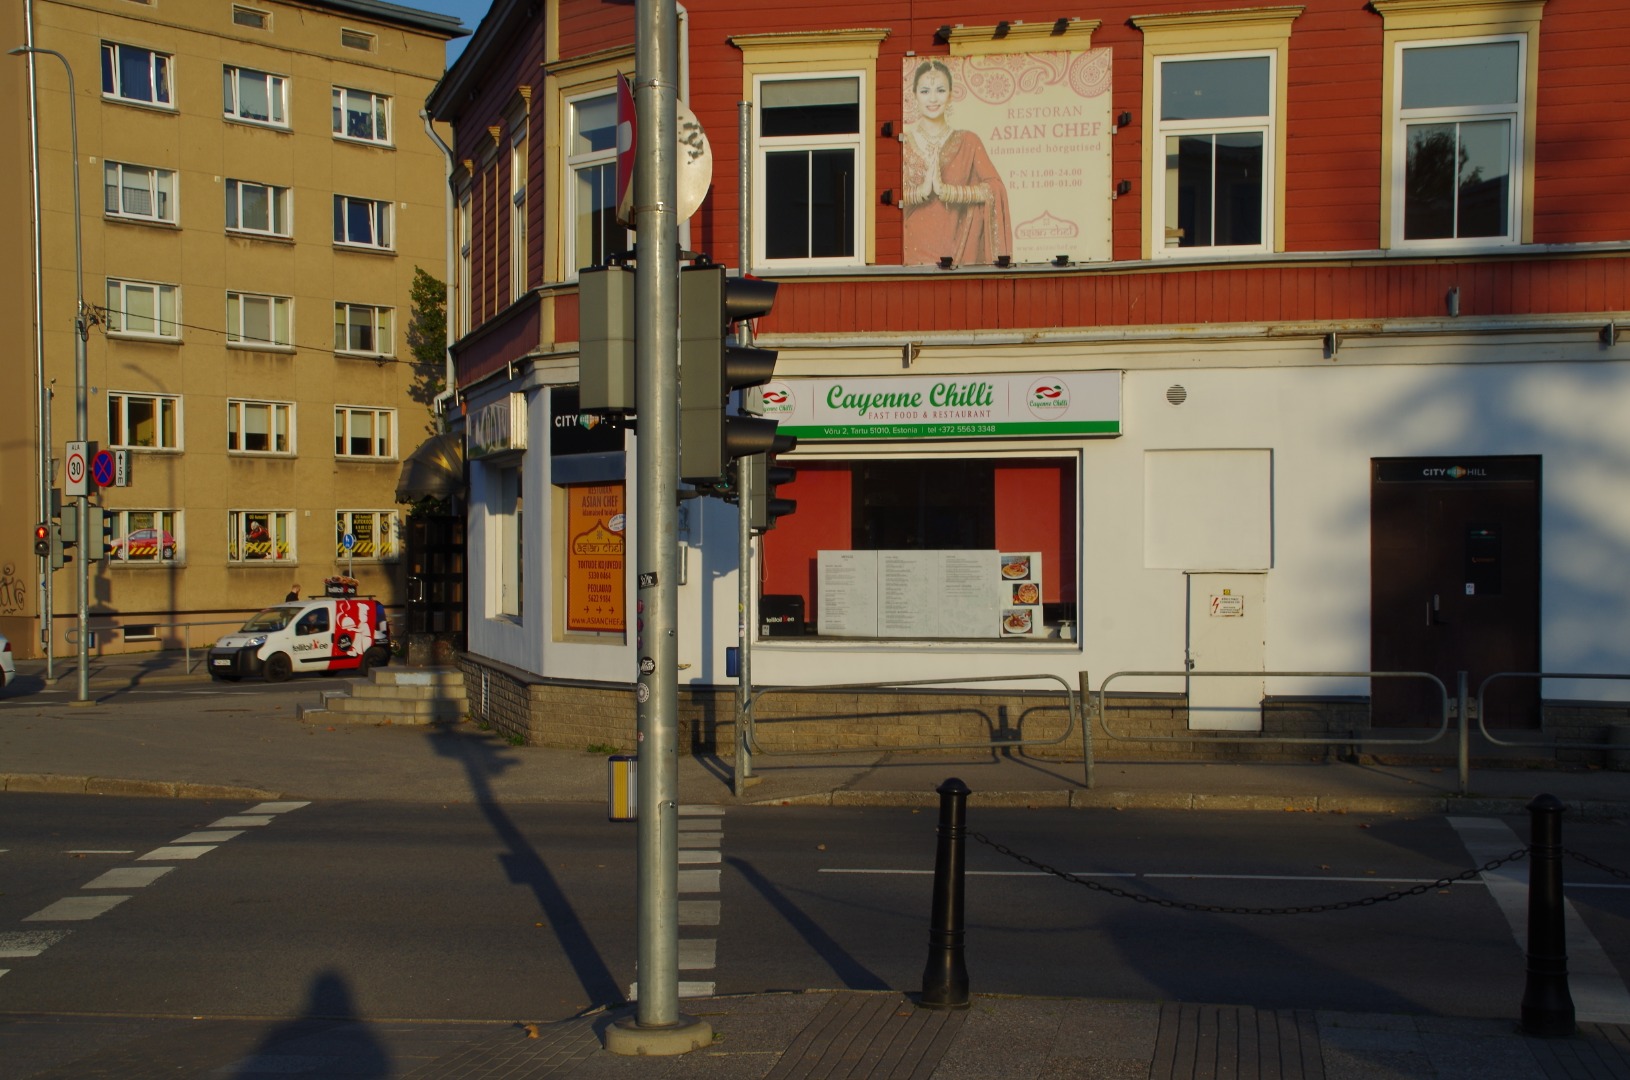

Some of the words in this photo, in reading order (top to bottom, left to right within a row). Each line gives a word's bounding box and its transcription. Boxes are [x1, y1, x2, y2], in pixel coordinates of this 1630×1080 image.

[1007, 105, 1082, 119] RESTORAN
[990, 124, 1047, 141] ASIAN
[1052, 121, 1101, 138] CHEF
[990, 144, 1041, 156] idamaised
[826, 384, 923, 417] Cayenne
[929, 381, 993, 407] Chilli
[555, 414, 578, 428] CITY
[868, 411, 890, 420] FAST
[894, 411, 918, 419] FOOD
[922, 410, 928, 418] &
[933, 410, 991, 419] RESTAURANT
[850, 427, 868, 435] Tartu
[870, 426, 890, 434] 51010,
[892, 426, 918, 434] Estonia
[957, 425, 975, 433] 5563
[977, 425, 996, 433] 3348
[71, 462, 81, 475] 30
[118, 467, 123, 476] 5
[1422, 468, 1446, 476] CITY
[1467, 468, 1487, 476] HILL
[582, 495, 602, 508] ASIAN
[603, 495, 618, 507] CHEF
[576, 539, 600, 555] asian
